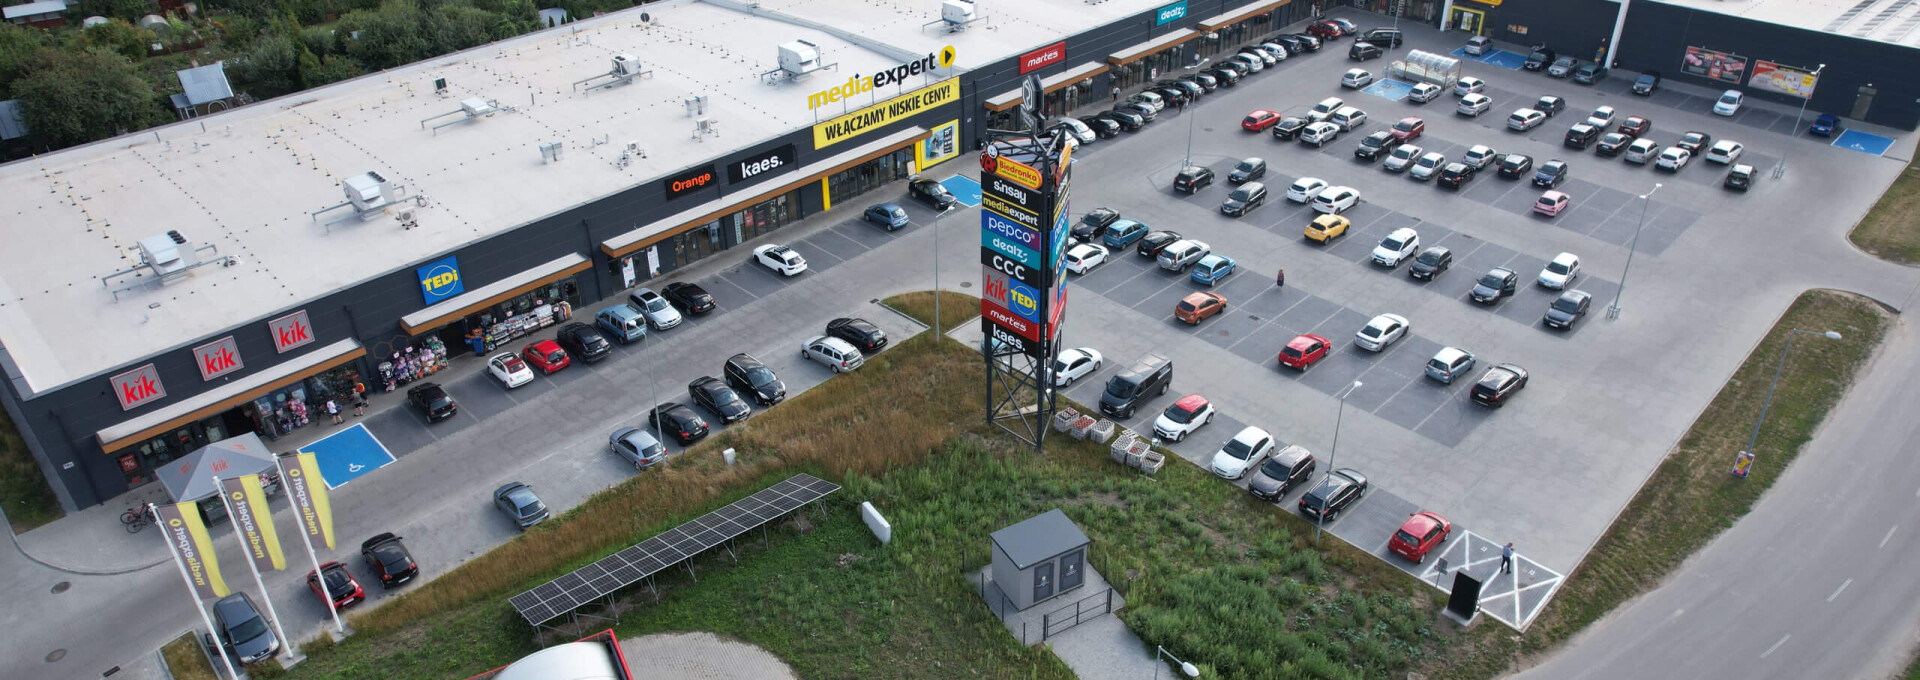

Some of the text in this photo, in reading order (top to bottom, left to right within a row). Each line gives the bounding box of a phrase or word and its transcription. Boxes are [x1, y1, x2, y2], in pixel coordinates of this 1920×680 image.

[1160, 5, 1185, 20] dealz
[1027, 49, 1059, 67] martes
[808, 52, 936, 110] mediaexpert
[825, 84, 951, 141] WŁĄCZAMY NISKIE CENY!
[741, 155, 783, 179] kaes.
[999, 160, 1037, 182] Biedronka
[672, 172, 711, 192] Orange
[993, 179, 1027, 205] sinsay
[983, 196, 1038, 227] mediaexpert
[992, 238, 1028, 263] dealz
[992, 255, 1026, 280] CCC
[422, 269, 459, 292] TEDi
[985, 275, 1007, 302] kik
[1010, 289, 1037, 311] TEDi
[278, 319, 308, 347] kik
[990, 309, 1027, 332] martes
[992, 323, 1026, 351] kaes.
[204, 346, 237, 375] kik
[122, 372, 158, 404] kik
